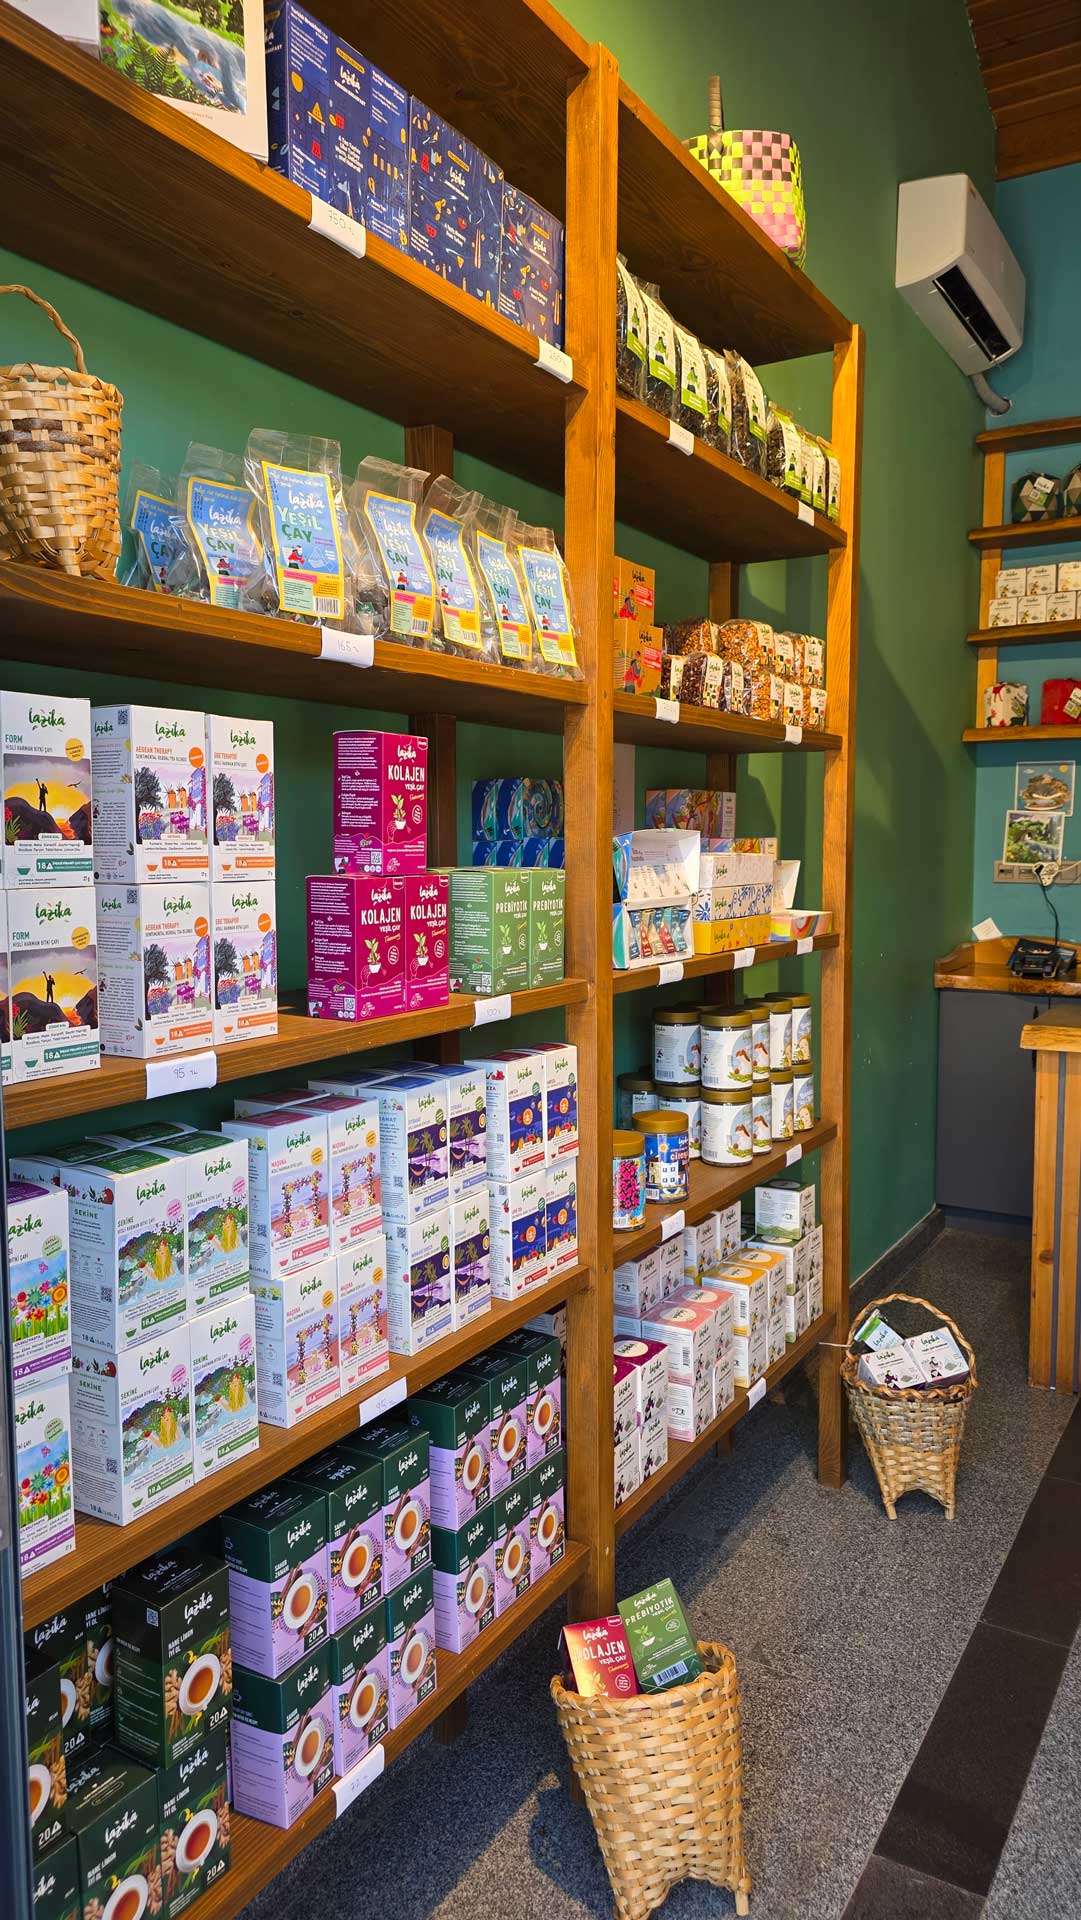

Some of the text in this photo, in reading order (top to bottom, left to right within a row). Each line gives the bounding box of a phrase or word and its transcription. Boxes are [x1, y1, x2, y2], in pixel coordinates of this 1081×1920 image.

[277, 505, 322, 531] YEŞİL
[282, 524, 312, 543] ÇAY
[206, 537, 235, 554] ÇAY
[387, 549, 409, 566] ÇAY
[436, 556, 460, 572] EŞİL
[5, 734, 23, 744] FORM
[388, 765, 425, 783] KOLAJEN
[37, 861, 48, 870] 18
[495, 900, 528, 914] PREBİYOTİK
[533, 897, 563, 912] PREBİYOTİK
[361, 907, 400, 927] KOLAJEN
[410, 903, 447, 924] KOLAJEN
[12, 931, 30, 941] FORM
[45, 1048, 54, 1059] 18
[173, 1066, 185, 1079] 95
[8, 1214, 43, 1237] azika
[14, 1368, 23, 1378] 18
[15, 1402, 45, 1426] azika
[363, 1591, 372, 1602] 20
[308, 1631, 317, 1643] 20
[615, 1655, 627, 1663] ÇAY
[209, 1713, 220, 1727] 20
[64, 1737, 76, 1752] 20
[38, 1831, 51, 1847] 20
[206, 1866, 217, 1881] 20
